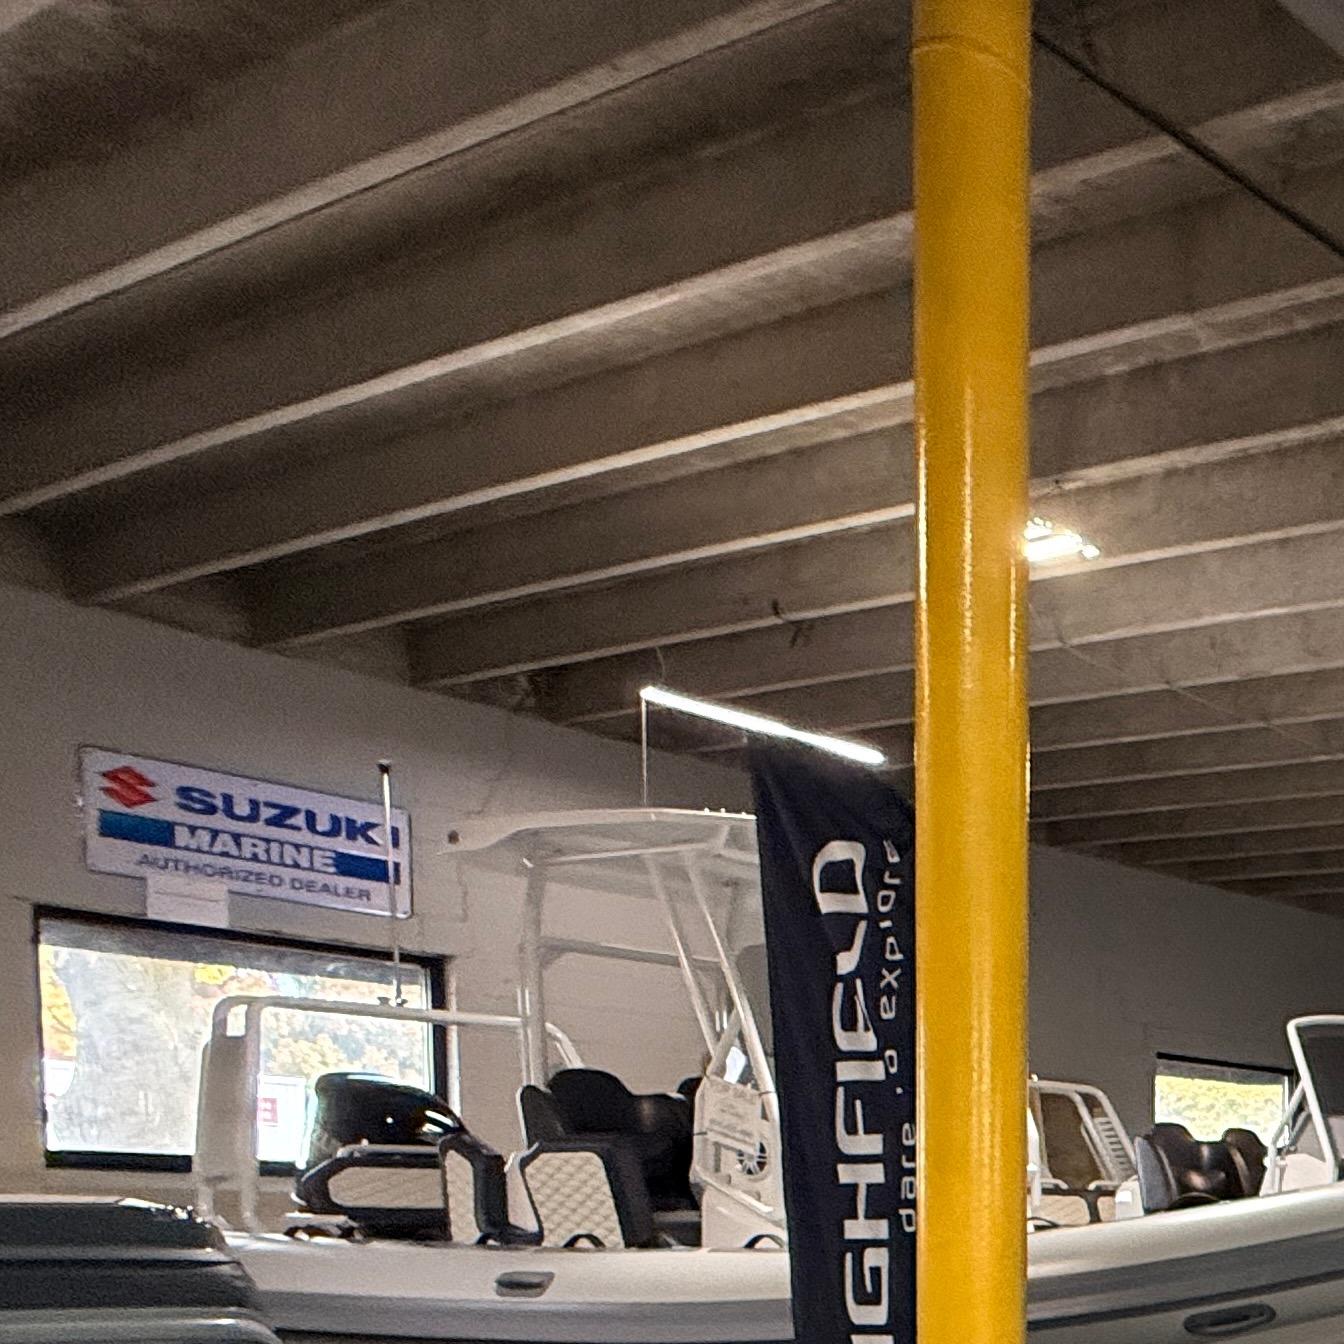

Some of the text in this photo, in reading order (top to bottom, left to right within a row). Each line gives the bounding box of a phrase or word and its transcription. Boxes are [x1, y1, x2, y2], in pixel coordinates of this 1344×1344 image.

[175, 785, 400, 849] SUZUKI
[138, 852, 372, 902] AUTHORIZED DEALER
[171, 823, 337, 874] MARINE
[899, 1122, 917, 1234] dare
